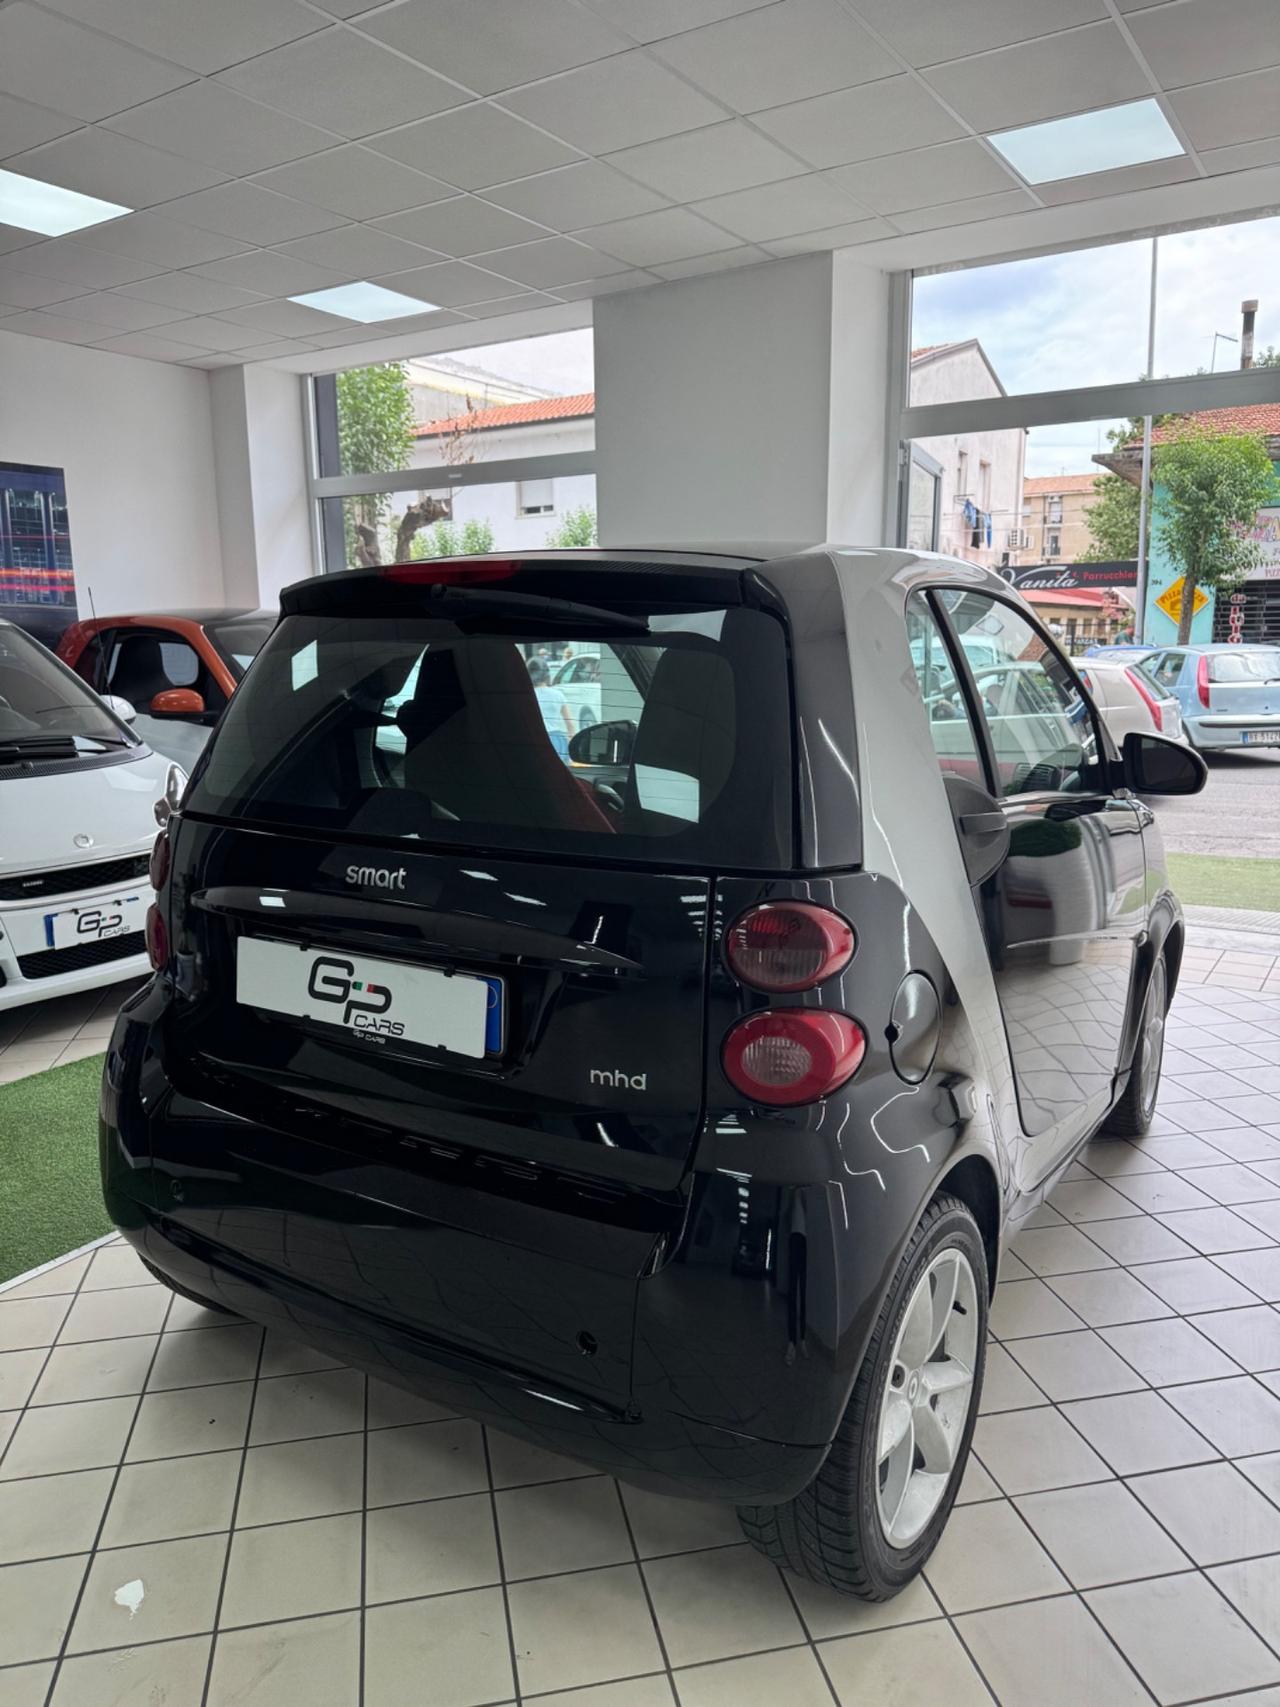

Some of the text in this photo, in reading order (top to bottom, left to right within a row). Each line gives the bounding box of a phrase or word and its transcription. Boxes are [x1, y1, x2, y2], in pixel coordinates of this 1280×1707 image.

[1083, 570, 1138, 582] Parrucchier
[345, 864, 407, 890] smart
[103, 925, 131, 937] CARS
[354, 1014, 405, 1036] CARS
[590, 1068, 648, 1091] mhd
